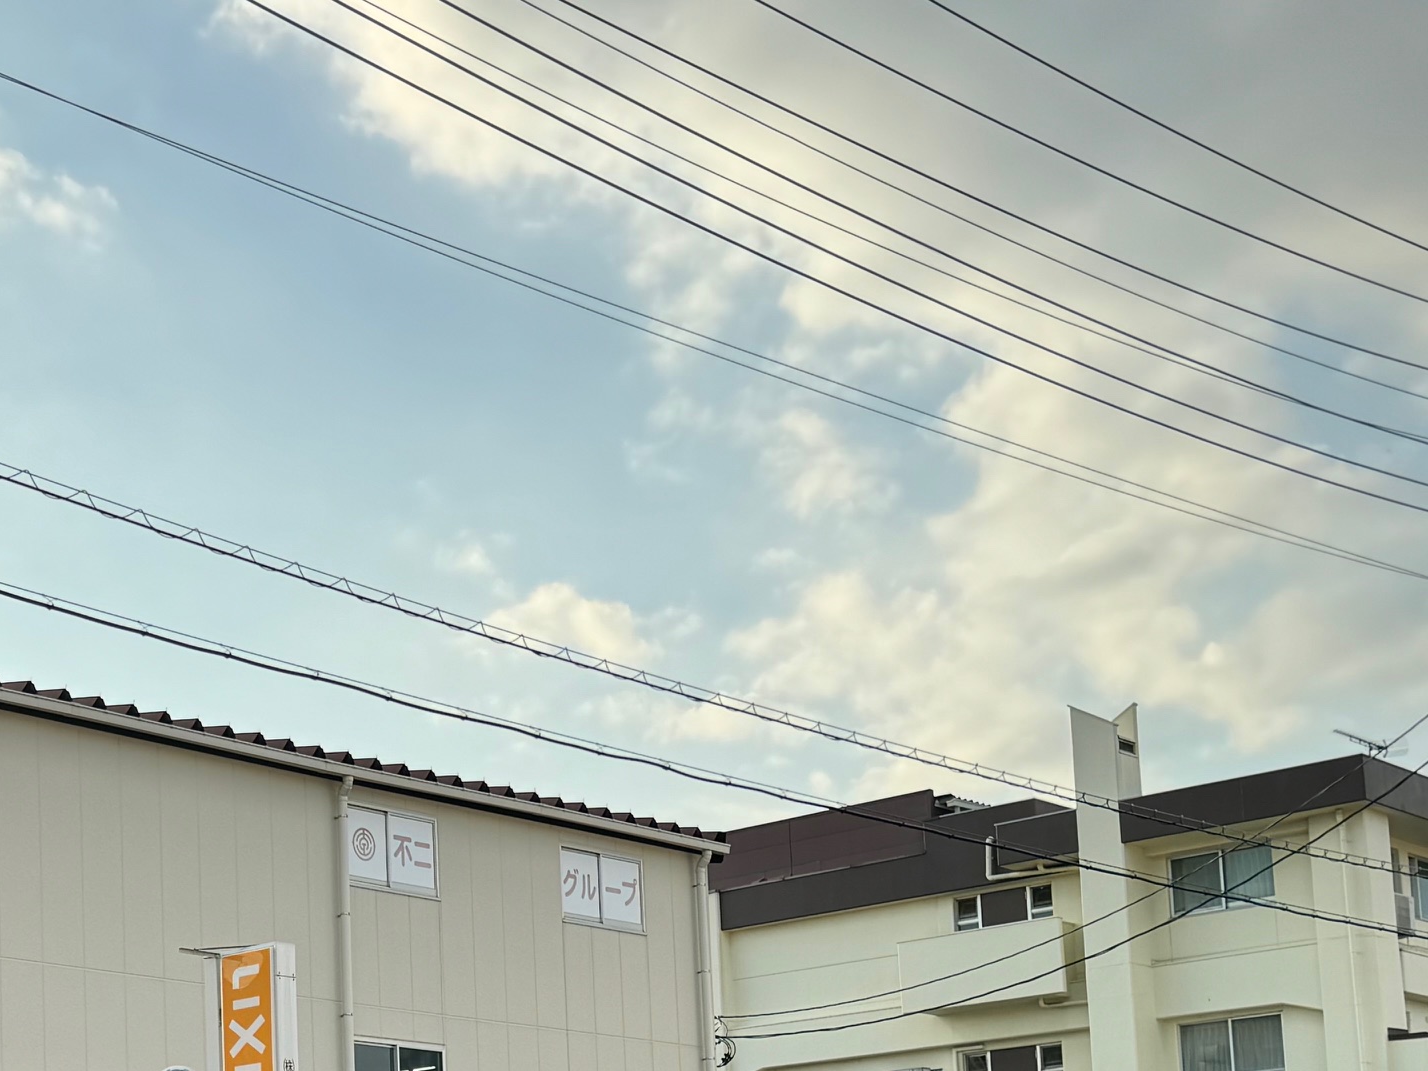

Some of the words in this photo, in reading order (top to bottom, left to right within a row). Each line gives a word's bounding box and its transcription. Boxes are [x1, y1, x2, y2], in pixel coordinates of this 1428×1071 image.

[393, 834, 432, 869] 不二
[563, 869, 638, 906] グループ
